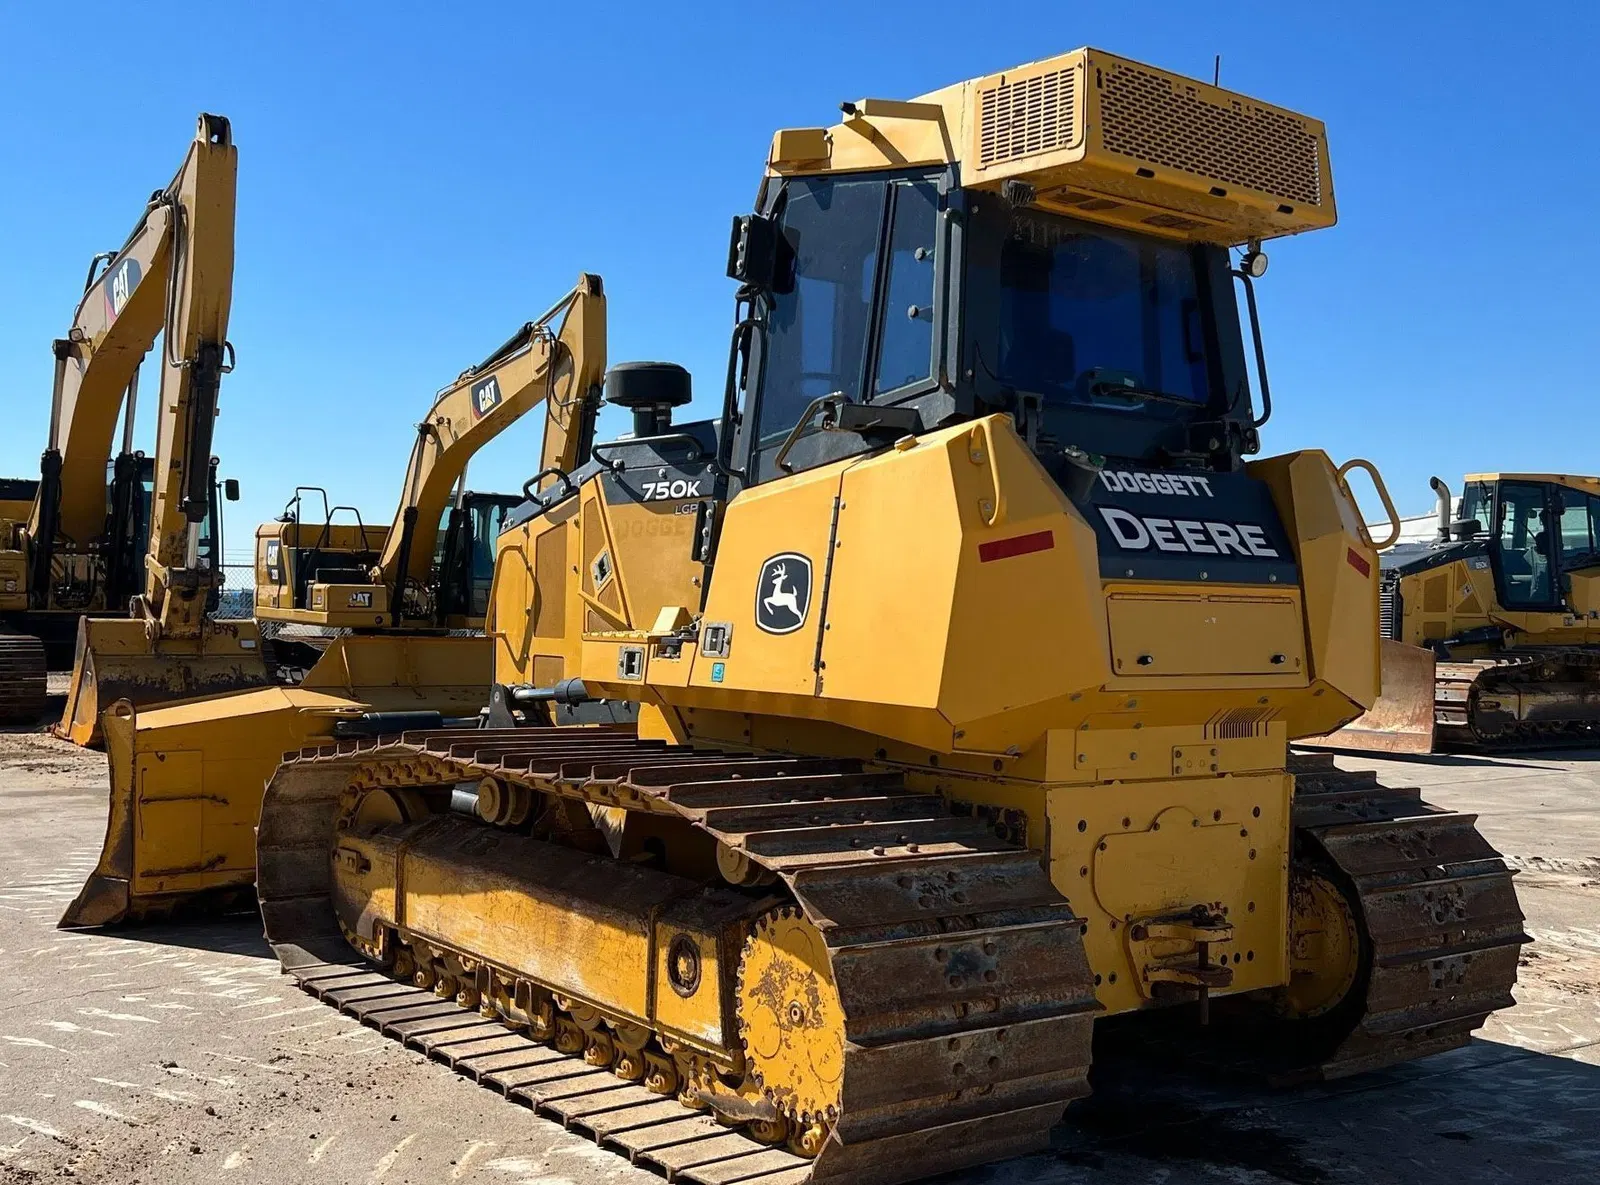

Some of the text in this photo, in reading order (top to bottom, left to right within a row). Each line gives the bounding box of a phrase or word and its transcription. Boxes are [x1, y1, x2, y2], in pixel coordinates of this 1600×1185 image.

[112, 260, 129, 316] CAT
[479, 379, 496, 413] CAT
[642, 479, 701, 502] 750K
[1099, 470, 1214, 497] DOGGETT
[675, 503, 698, 515] LGP
[1098, 507, 1279, 557] DEERE
[348, 592, 371, 607] CAT
